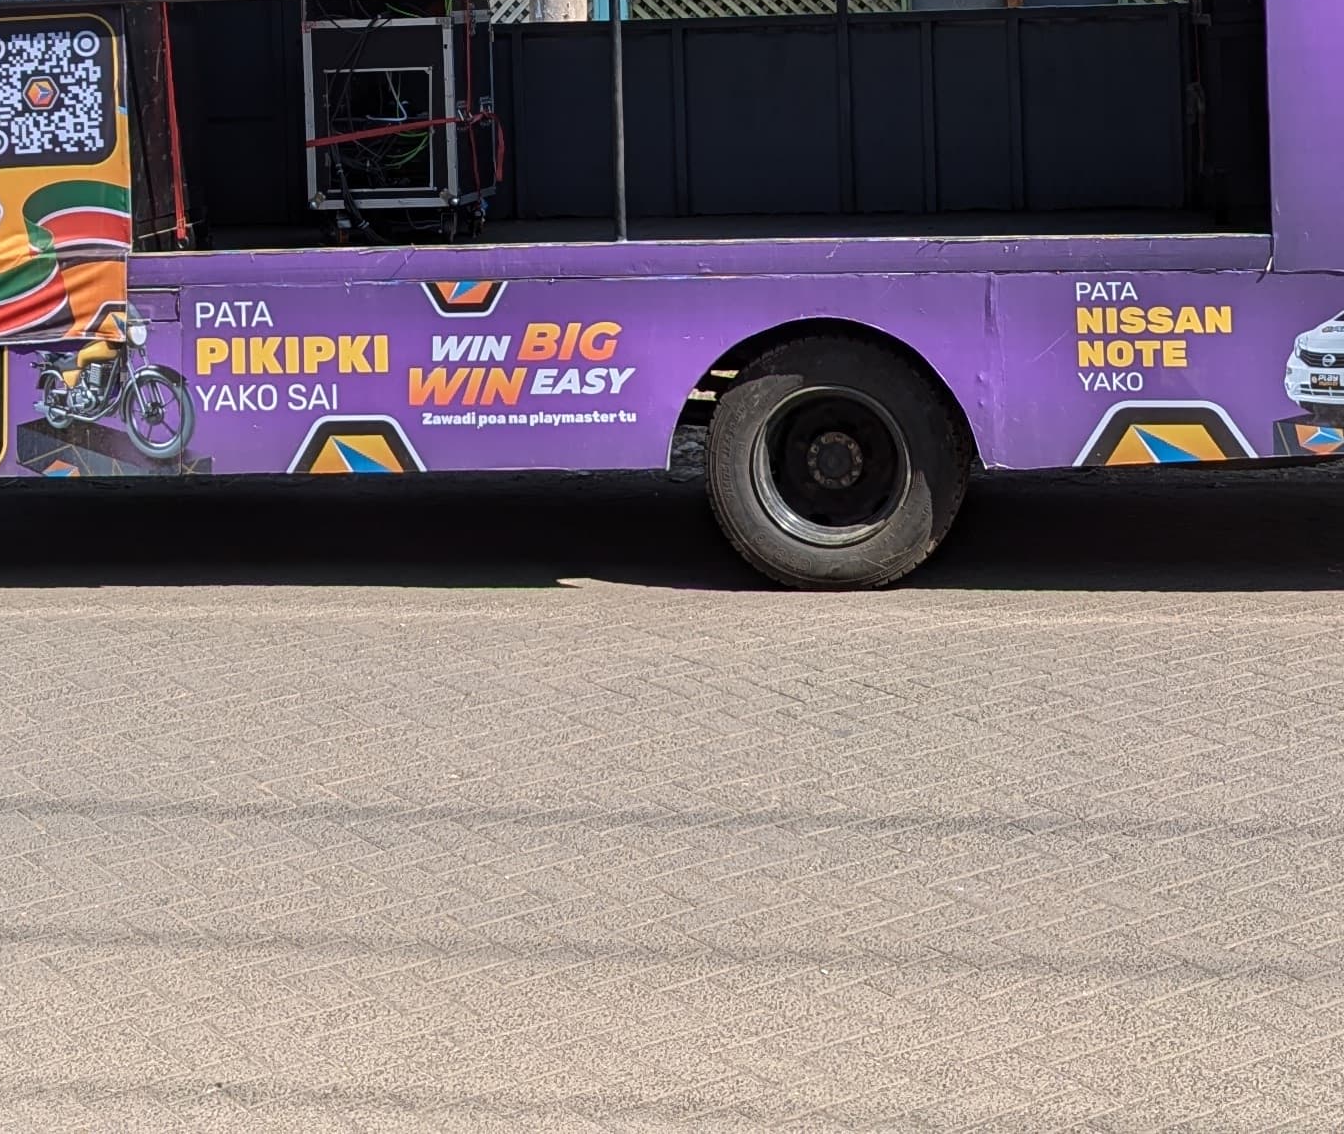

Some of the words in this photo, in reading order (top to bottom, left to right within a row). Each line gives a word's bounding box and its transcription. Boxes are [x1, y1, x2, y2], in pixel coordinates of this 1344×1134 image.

[1076, 282, 1138, 302] PATA
[195, 301, 273, 329] PATA
[1076, 306, 1233, 334] NISSAN
[196, 335, 389, 375] PIKIPKI
[431, 335, 511, 362] WIN
[517, 321, 623, 362] BIG
[1078, 340, 1188, 368] NOTE
[409, 366, 527, 406] WIN
[529, 368, 637, 396] EASY
[1078, 372, 1143, 392] YAKO
[196, 384, 279, 412] YAKO
[287, 383, 338, 411] SAI
[422, 410, 477, 427] Zawadi
[478, 412, 506, 429] poa
[508, 412, 528, 425] na
[529, 409, 619, 429] playmaster
[620, 410, 637, 424] tu
